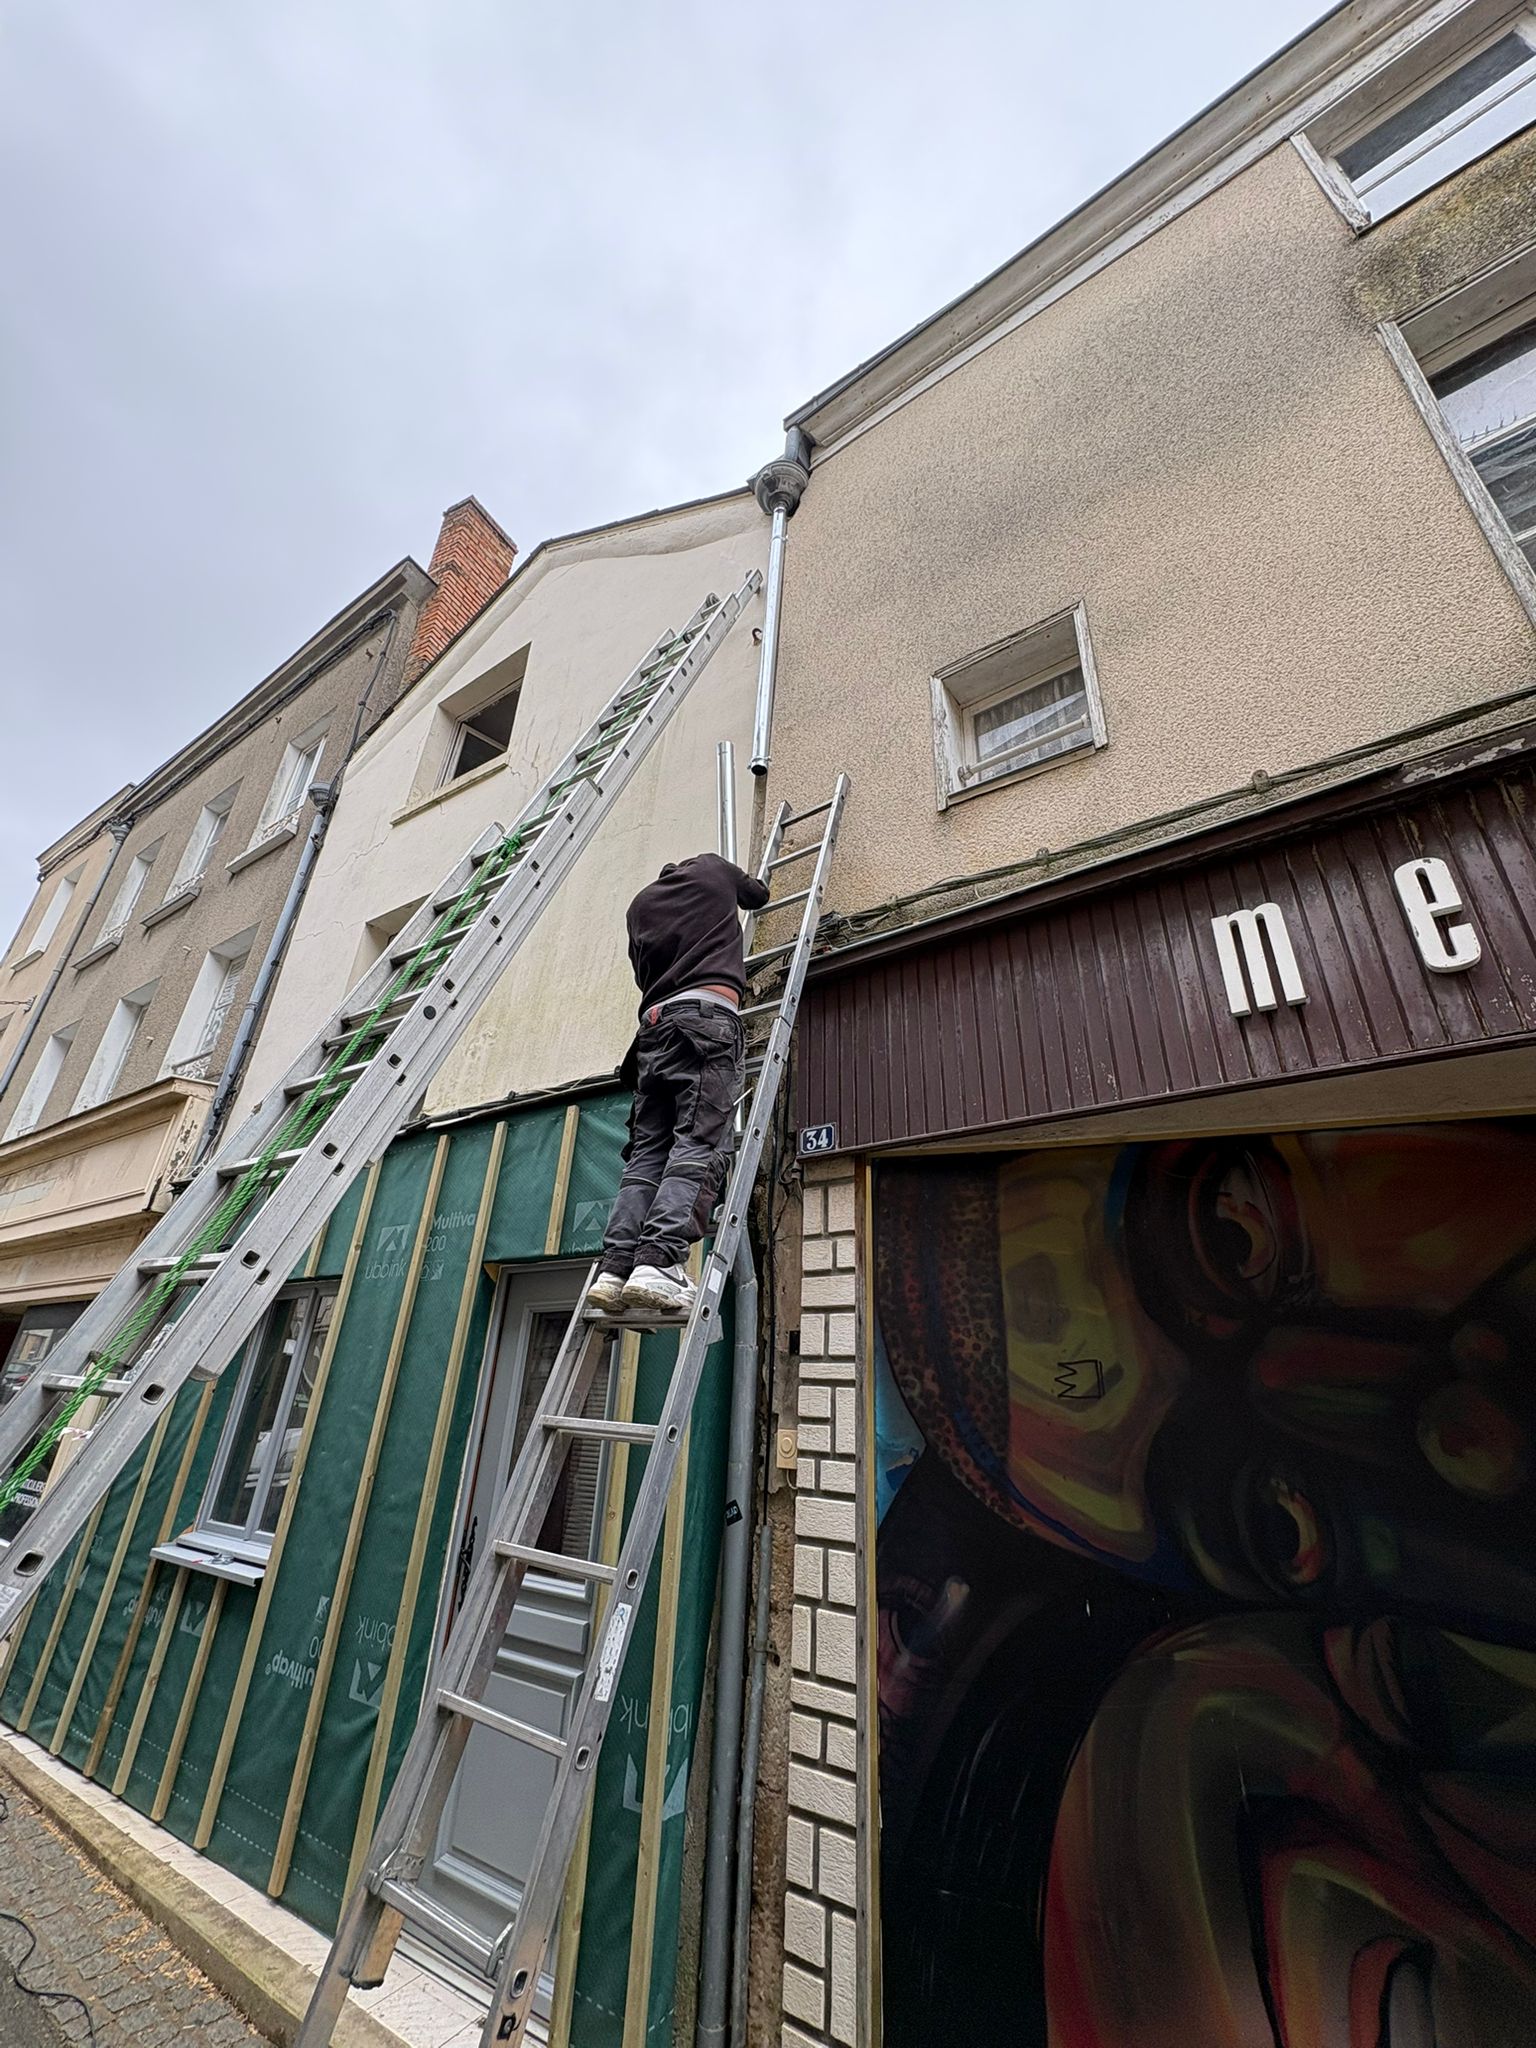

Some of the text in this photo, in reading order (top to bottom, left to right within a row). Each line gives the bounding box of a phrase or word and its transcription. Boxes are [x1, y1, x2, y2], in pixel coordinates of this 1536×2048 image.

[806, 1128, 829, 1150] 34
[364, 1258, 407, 1280] ubbink
[356, 1615, 397, 1651] bbink
[264, 1649, 316, 1690] ultivap®
